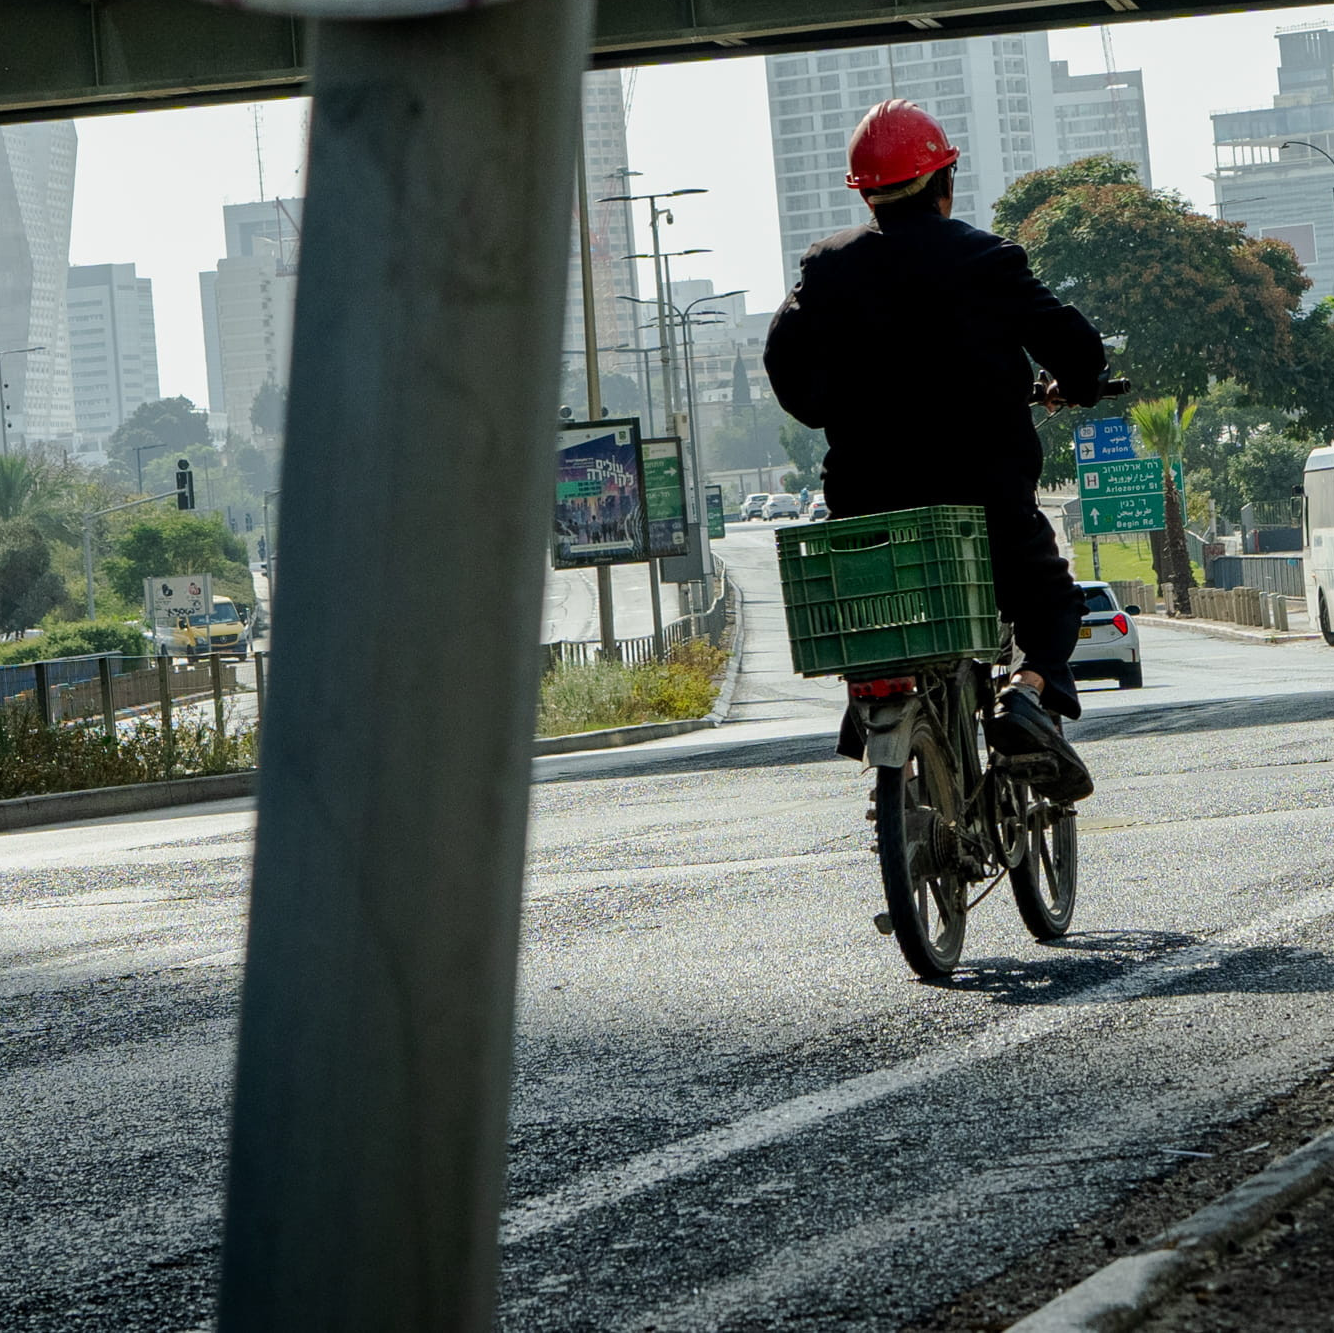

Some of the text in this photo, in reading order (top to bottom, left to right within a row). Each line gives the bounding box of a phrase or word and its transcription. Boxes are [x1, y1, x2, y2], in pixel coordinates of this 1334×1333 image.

[1104, 425, 1123, 434] דרום
[1102, 445, 1129, 455] Ayalon
[1148, 482, 1158, 490] St
[1120, 500, 1135, 509] בגין
[1116, 518, 1154, 529] Begin Rd
